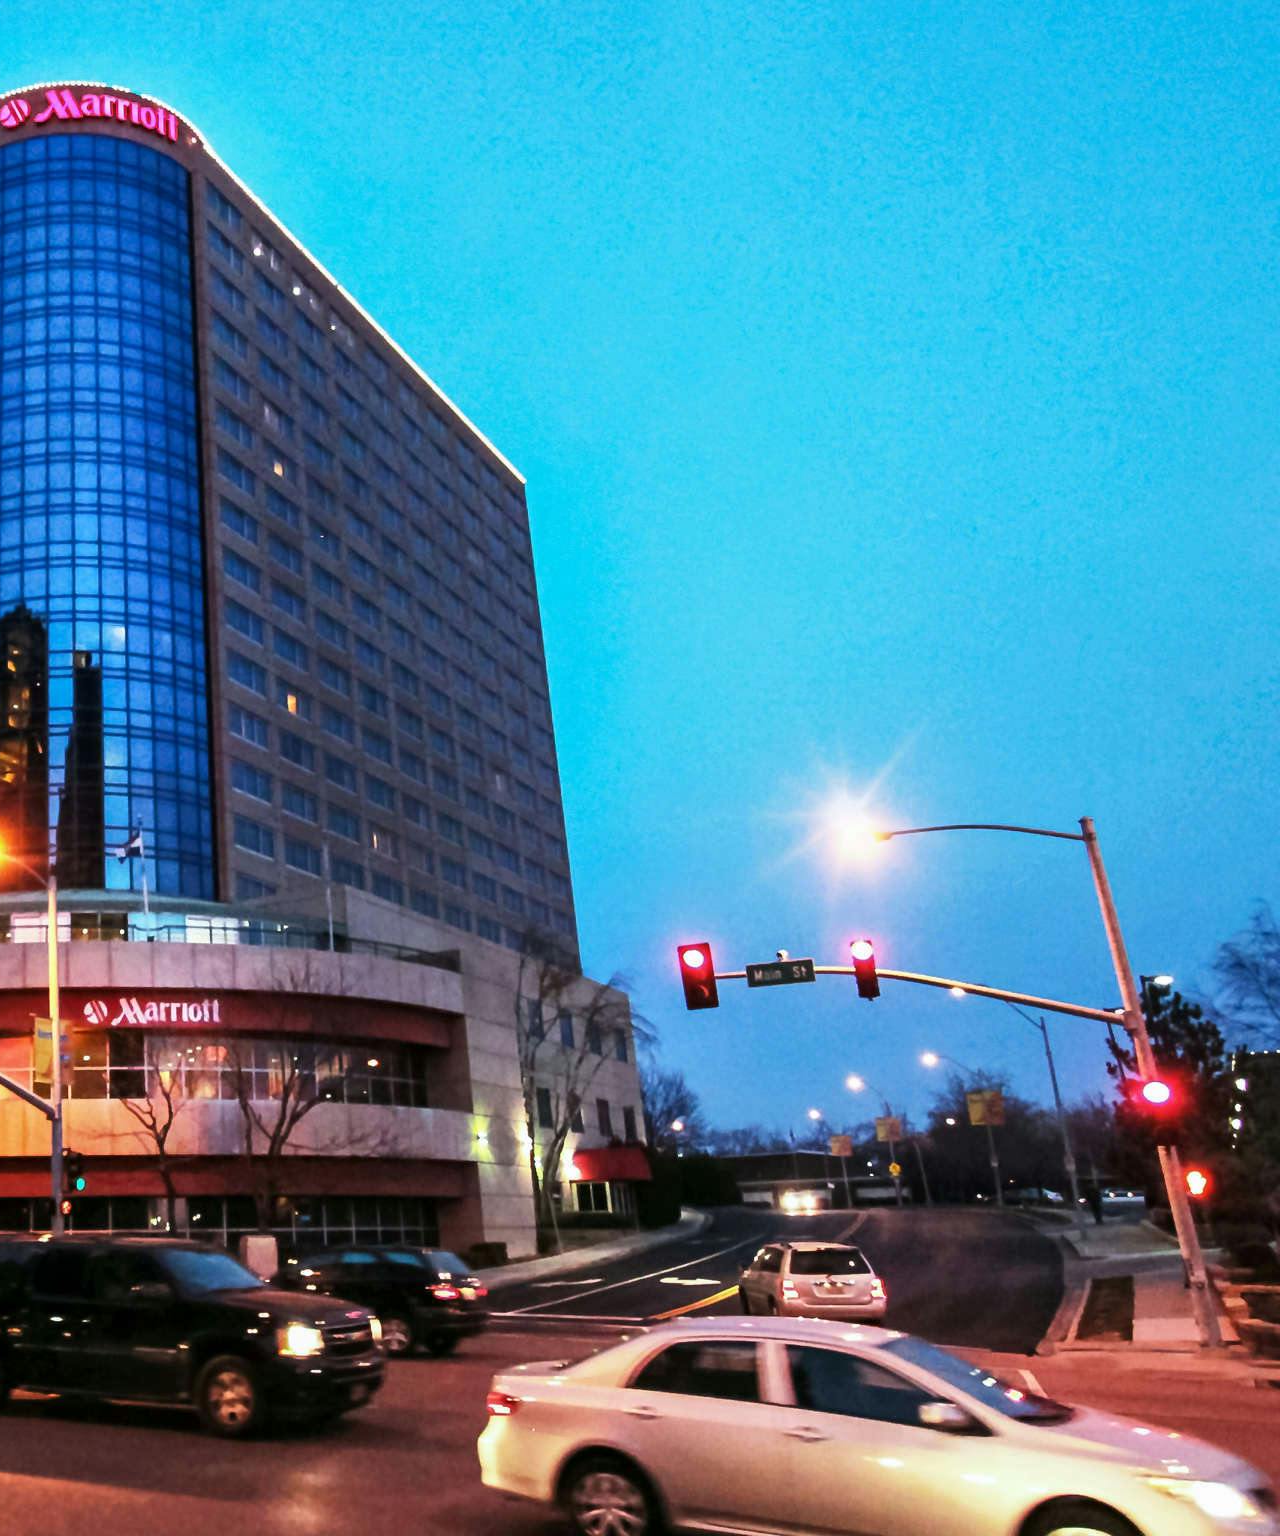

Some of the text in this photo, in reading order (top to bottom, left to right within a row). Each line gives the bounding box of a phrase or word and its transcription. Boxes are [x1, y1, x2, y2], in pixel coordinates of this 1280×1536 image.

[33, 88, 179, 142] Marriott
[753, 965, 808, 982] Main St
[111, 997, 222, 1026] Marriott
